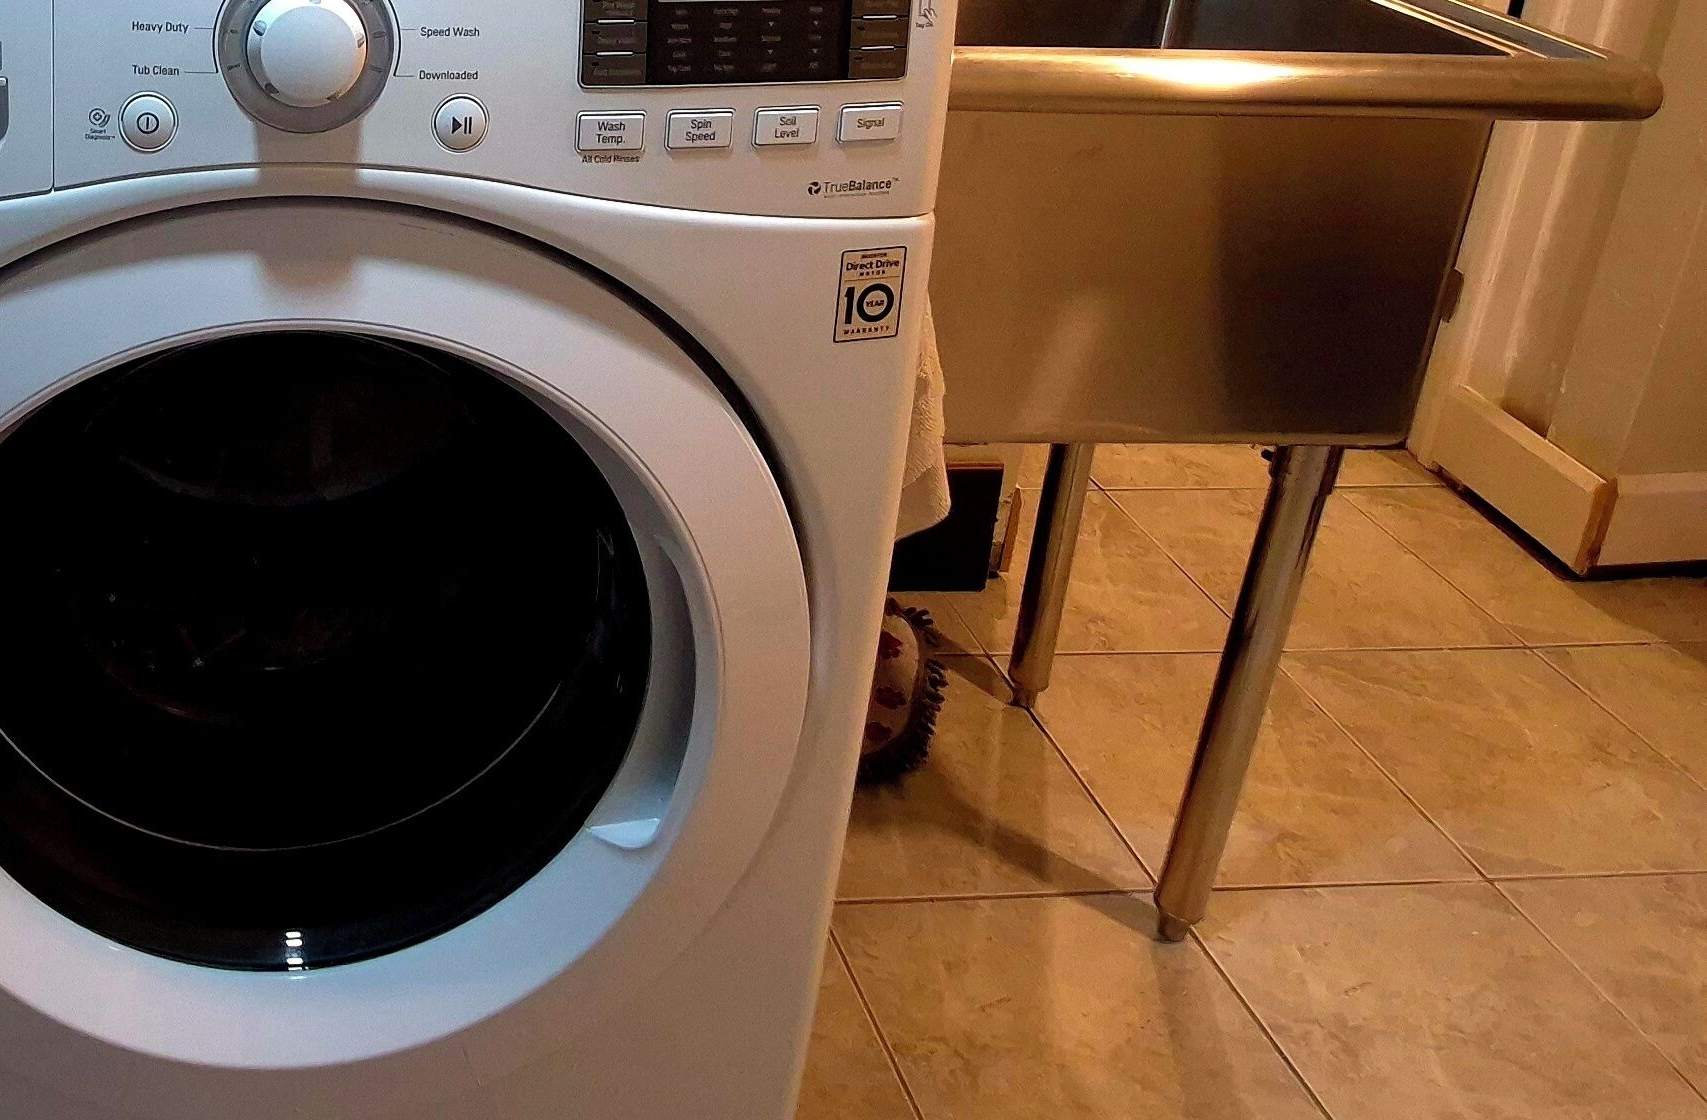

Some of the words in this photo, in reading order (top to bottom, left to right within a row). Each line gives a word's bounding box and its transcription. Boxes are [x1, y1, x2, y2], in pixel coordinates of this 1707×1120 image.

[132, 21, 163, 34] Heavy
[165, 21, 190, 35] Duty
[420, 26, 451, 38] Speed
[452, 27, 480, 37] Wash
[132, 64, 150, 75] Tub
[152, 65, 180, 76] Clean
[419, 70, 479, 80] Downloaded
[597, 120, 626, 132] Wash
[690, 119, 712, 131] Spin
[779, 116, 797, 126] Soil
[857, 118, 885, 130] Signal
[596, 133, 626, 146] Temp.
[685, 131, 716, 143] Speed
[774, 128, 800, 139] Level
[846, 260, 874, 271] Direct
[876, 259, 900, 269] Drive
[844, 283, 895, 325] 10
[865, 299, 885, 308] YEAR
[842, 325, 890, 335] WARRANTY
